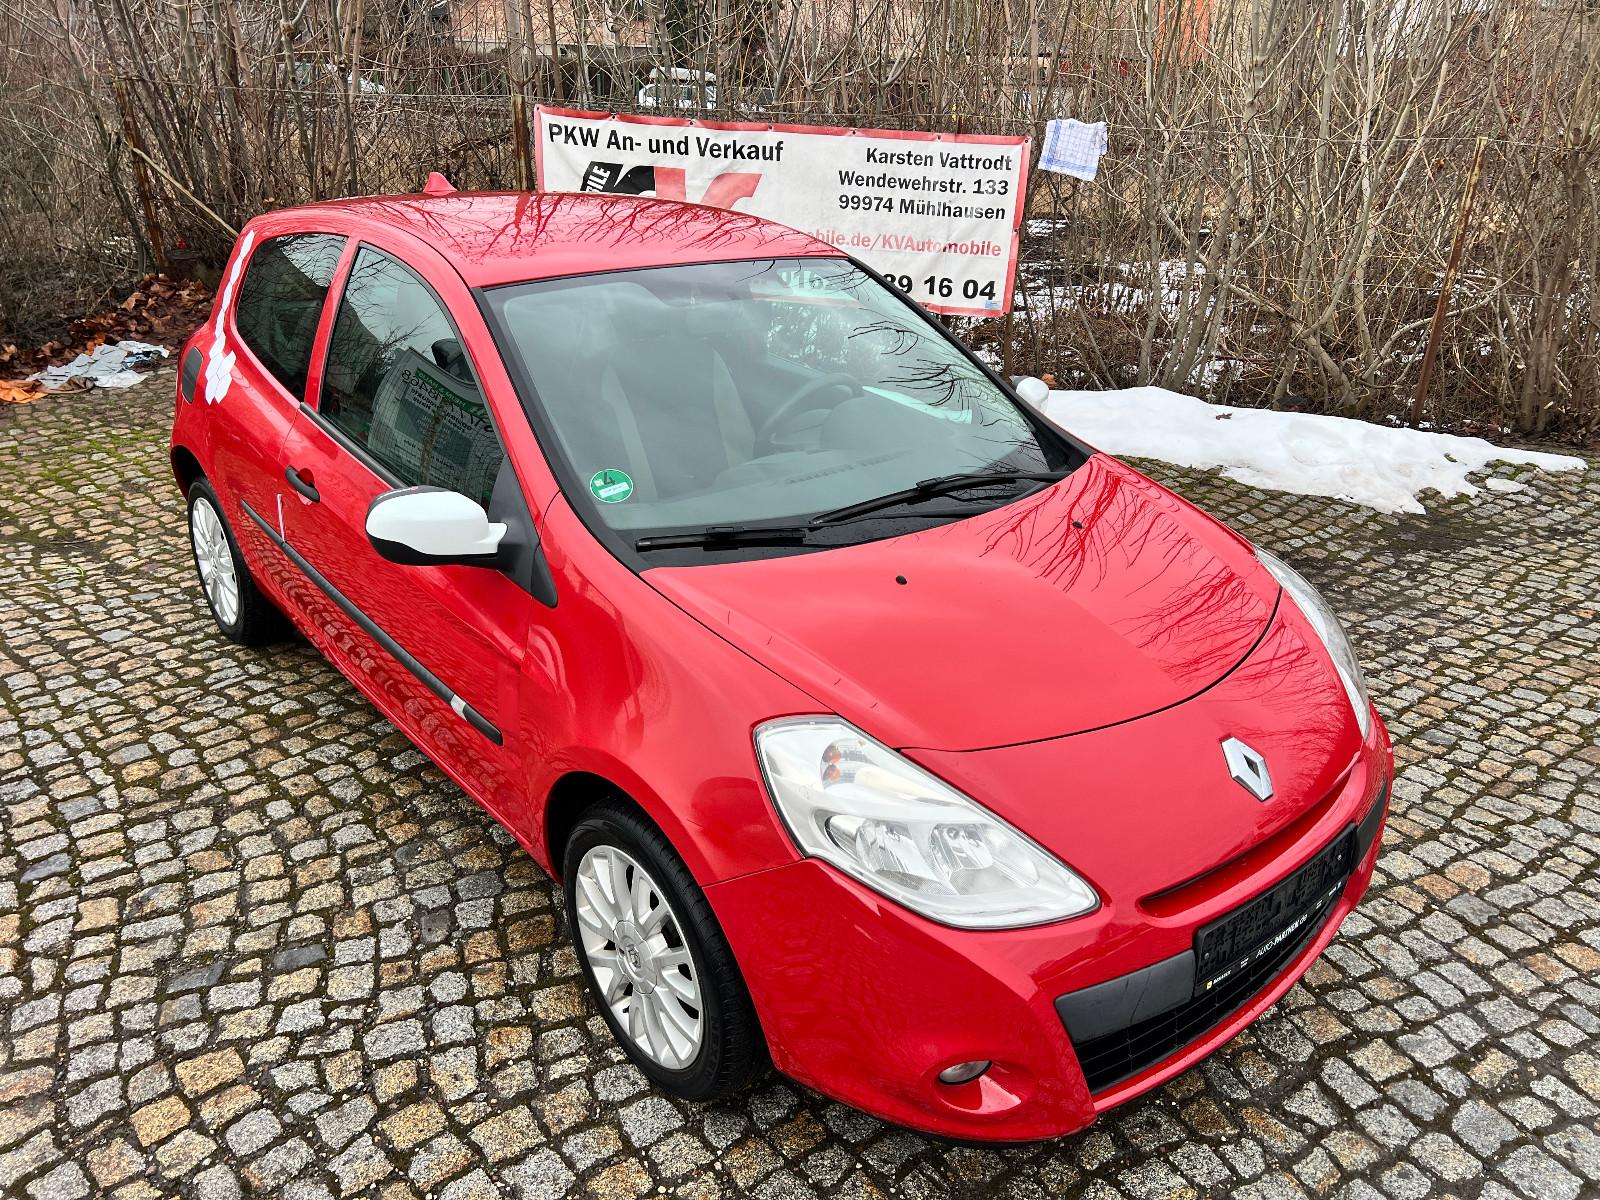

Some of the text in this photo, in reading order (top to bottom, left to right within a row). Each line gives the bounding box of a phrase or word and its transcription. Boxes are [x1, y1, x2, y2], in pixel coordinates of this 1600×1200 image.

[548, 123, 784, 162] PKW An- und Verkauf
[866, 147, 1012, 171] Karsten Vattrodt
[838, 170, 1009, 196] Wendewehrstr. 133
[838, 194, 1006, 220] 99974 Mühlhausen
[807, 228, 1002, 257] bile.de/KVAutomobile
[924, 275, 953, 298] 16
[962, 279, 996, 301] 04
[603, 471, 616, 486] 4
